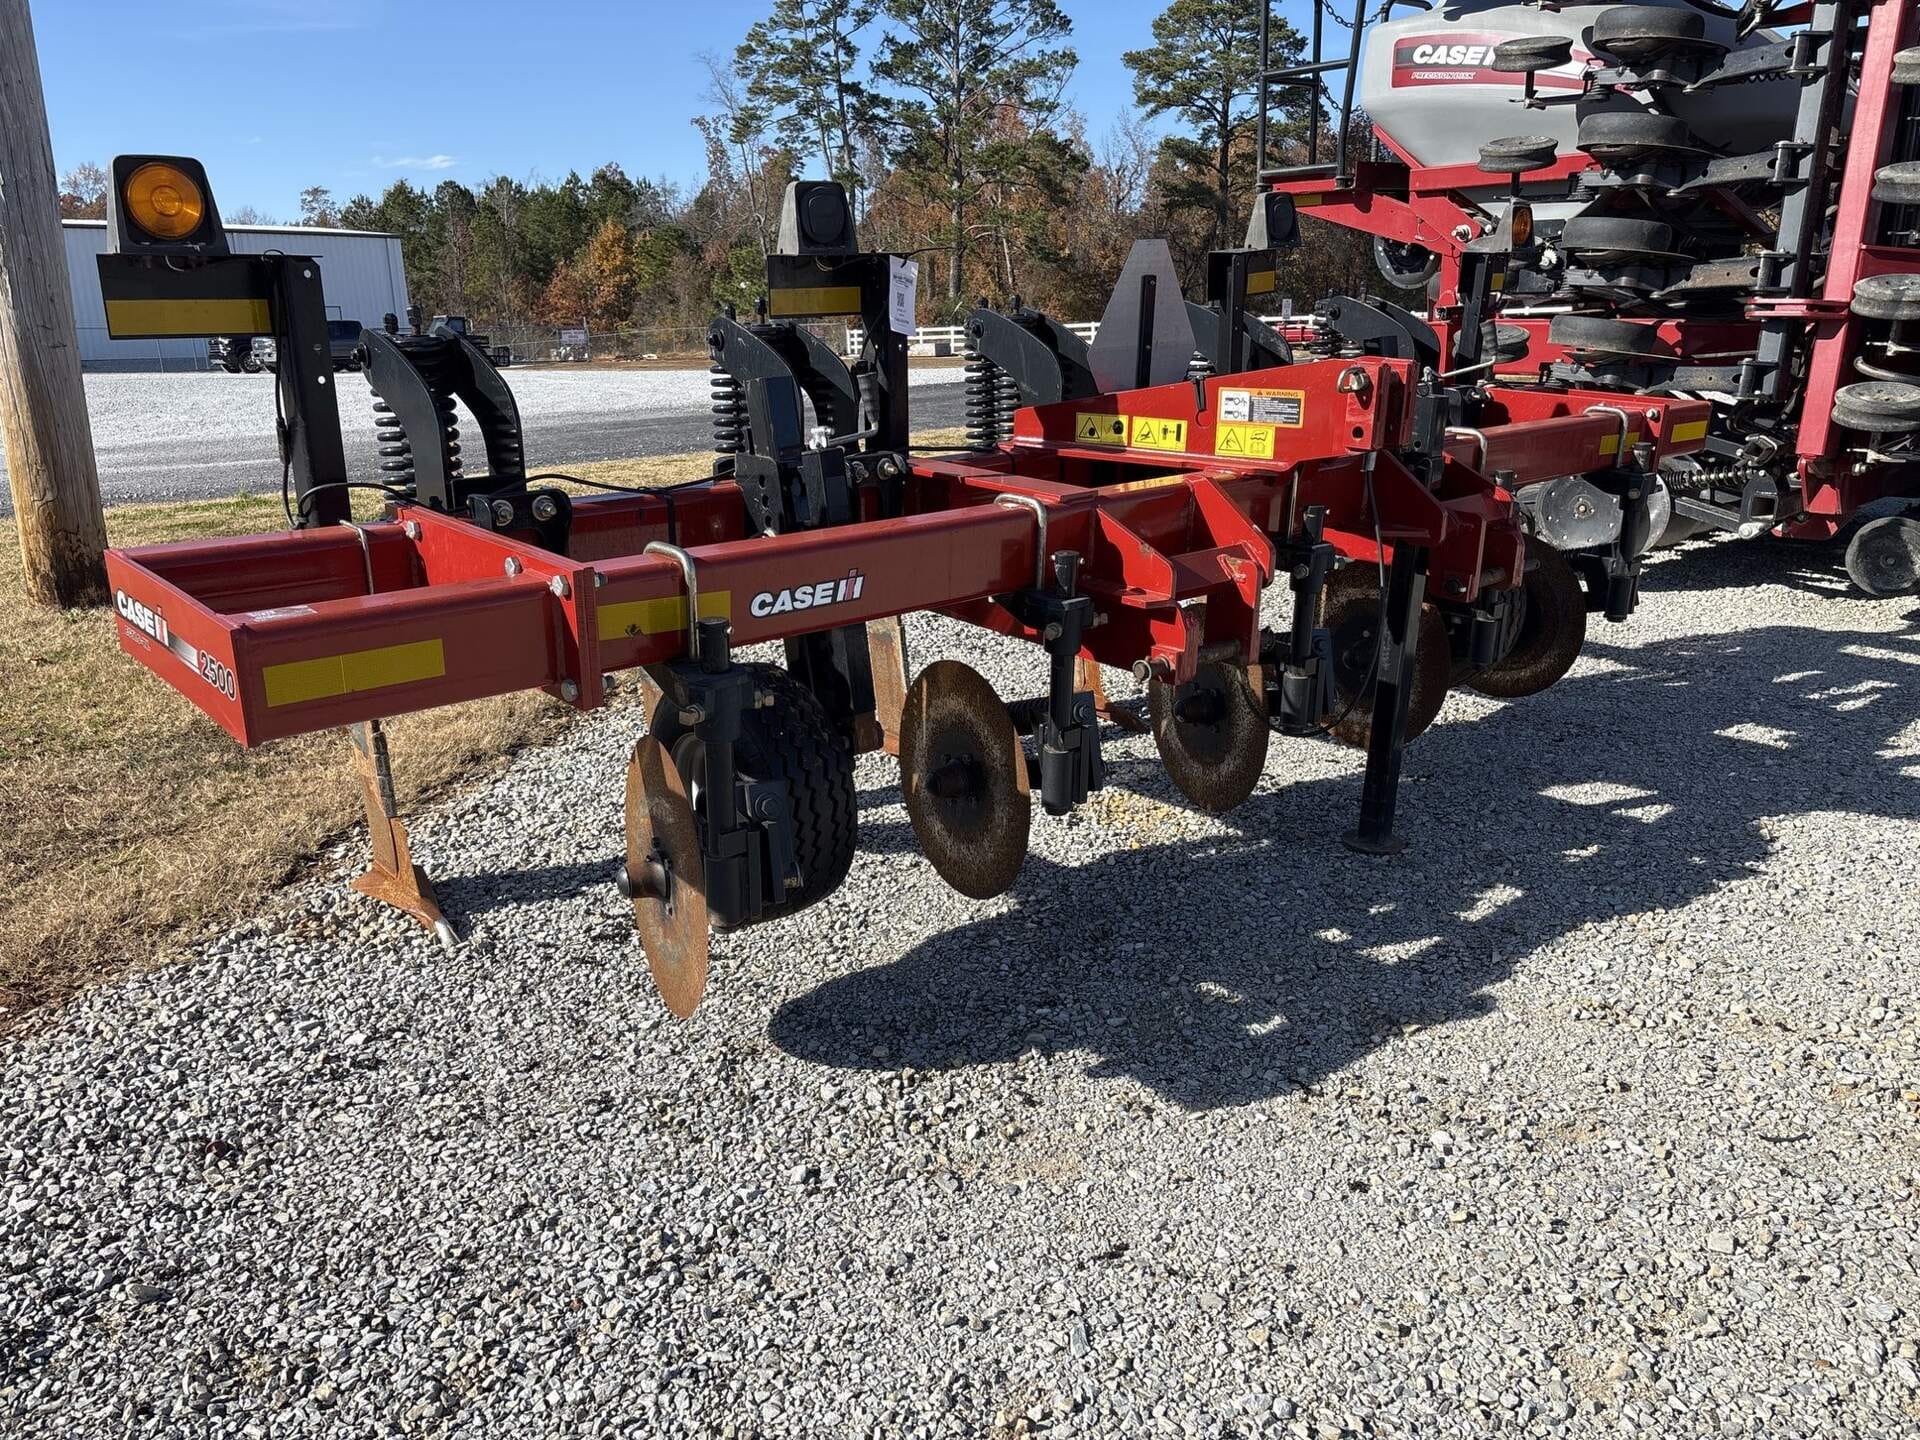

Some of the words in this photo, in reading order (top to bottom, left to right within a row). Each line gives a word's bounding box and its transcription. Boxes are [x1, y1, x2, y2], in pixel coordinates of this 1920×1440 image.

[1412, 44, 1487, 65] CASE
[1265, 390, 1299, 398] WARNING
[200, 650, 237, 701] 2500
